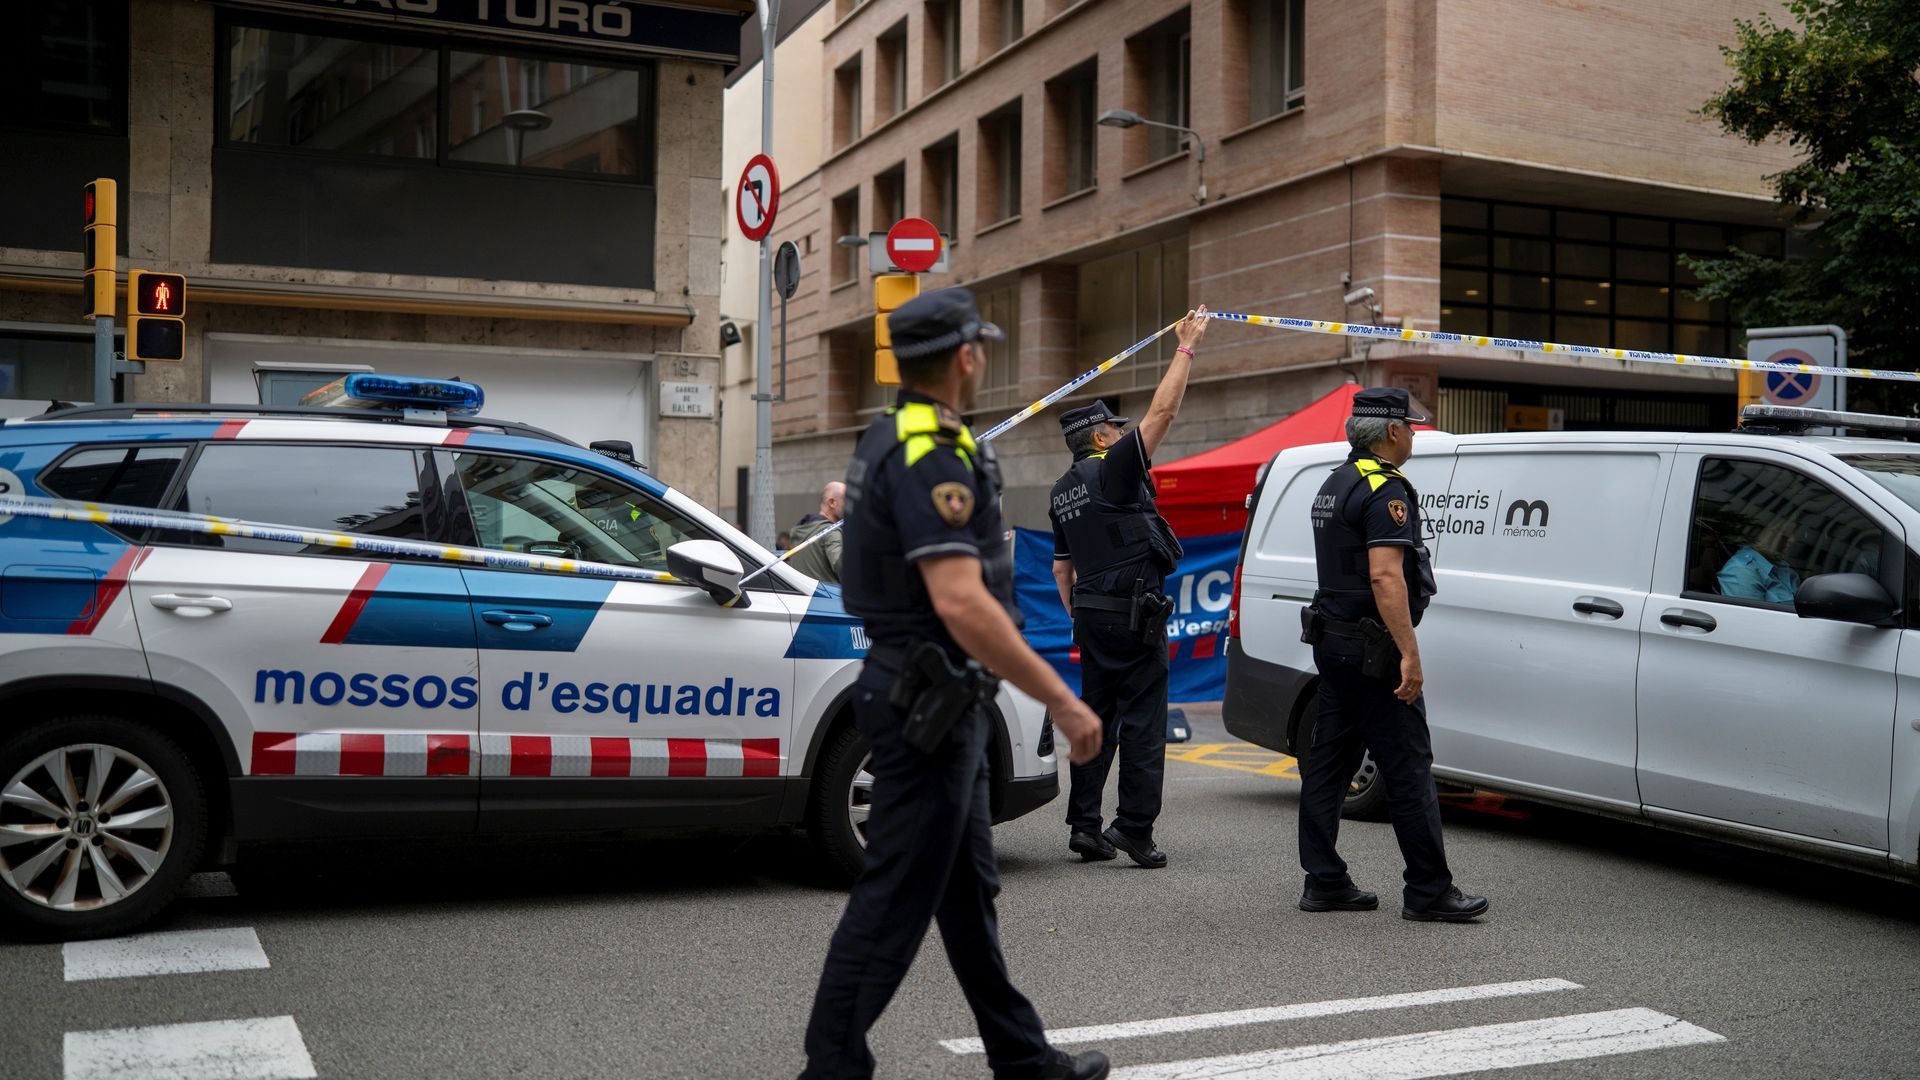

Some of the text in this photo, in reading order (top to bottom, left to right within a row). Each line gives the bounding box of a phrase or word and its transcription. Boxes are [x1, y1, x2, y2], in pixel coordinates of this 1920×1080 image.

[1279, 318, 1303, 327] PASSEU
[1347, 325, 1373, 334] POLICIA
[1493, 338, 1517, 347] POLICIA
[1053, 483, 1088, 509] POLICIA
[1313, 495, 1337, 509] OLICIA
[1503, 526, 1546, 538] mémora
[1168, 570, 1232, 614] IC
[254, 668, 780, 723] mossos d'esquadra
